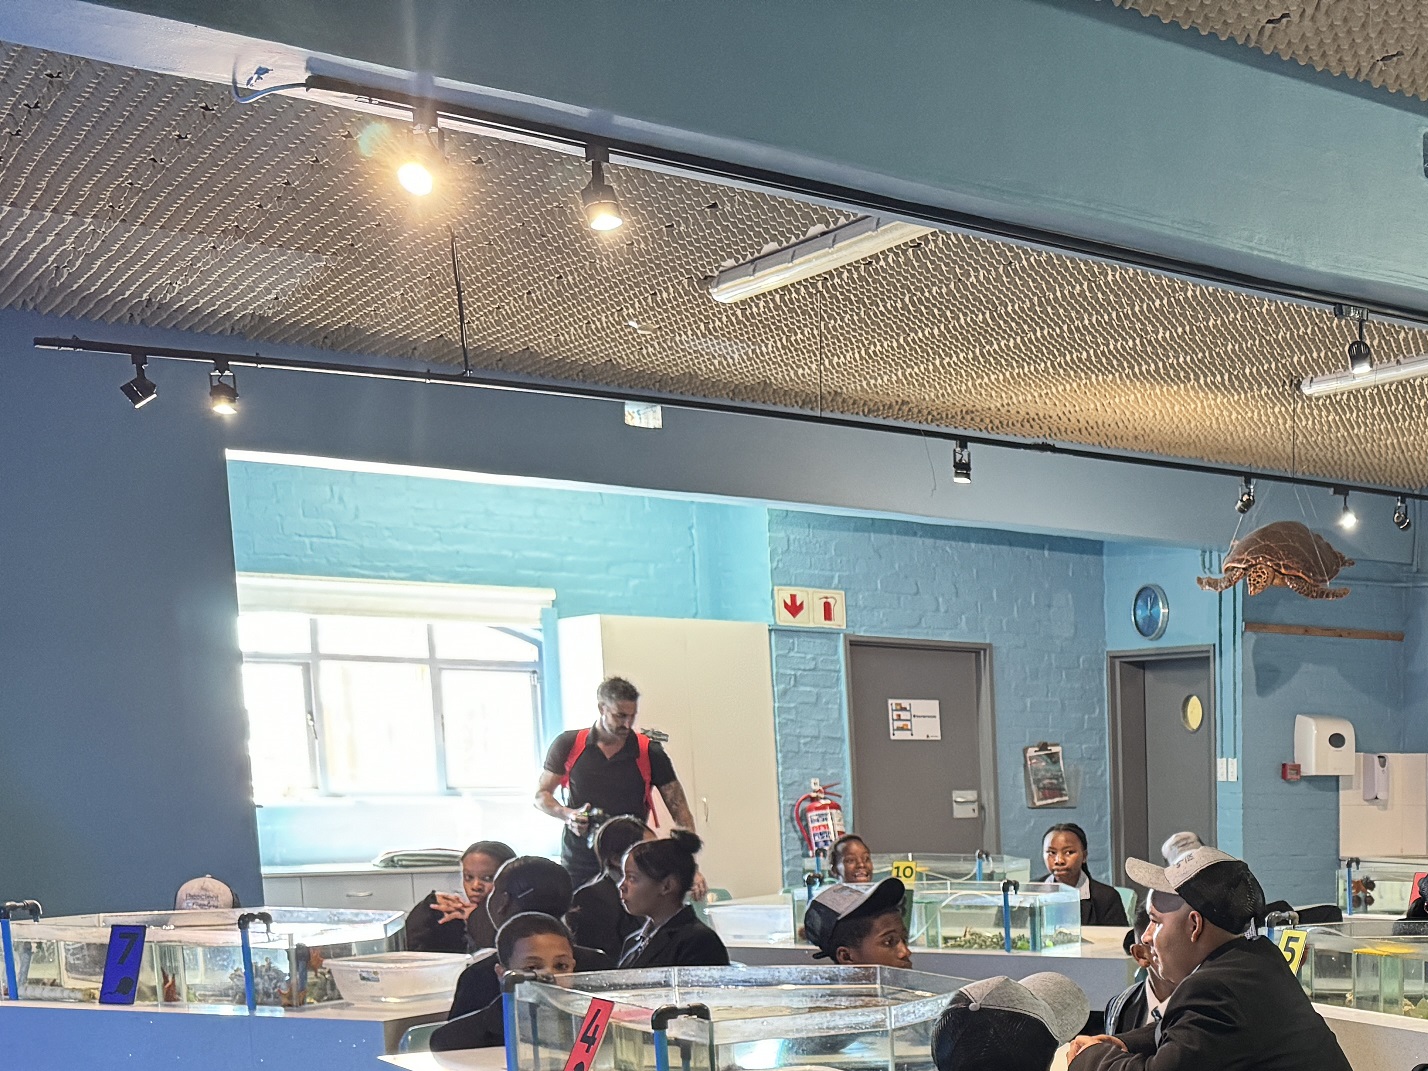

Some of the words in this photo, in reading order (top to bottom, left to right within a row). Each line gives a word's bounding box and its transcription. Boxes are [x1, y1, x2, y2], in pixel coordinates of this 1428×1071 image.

[894, 866, 914, 878] 10
[118, 932, 139, 965] 7
[1283, 936, 1300, 965] 5
[580, 1009, 601, 1053] 4
